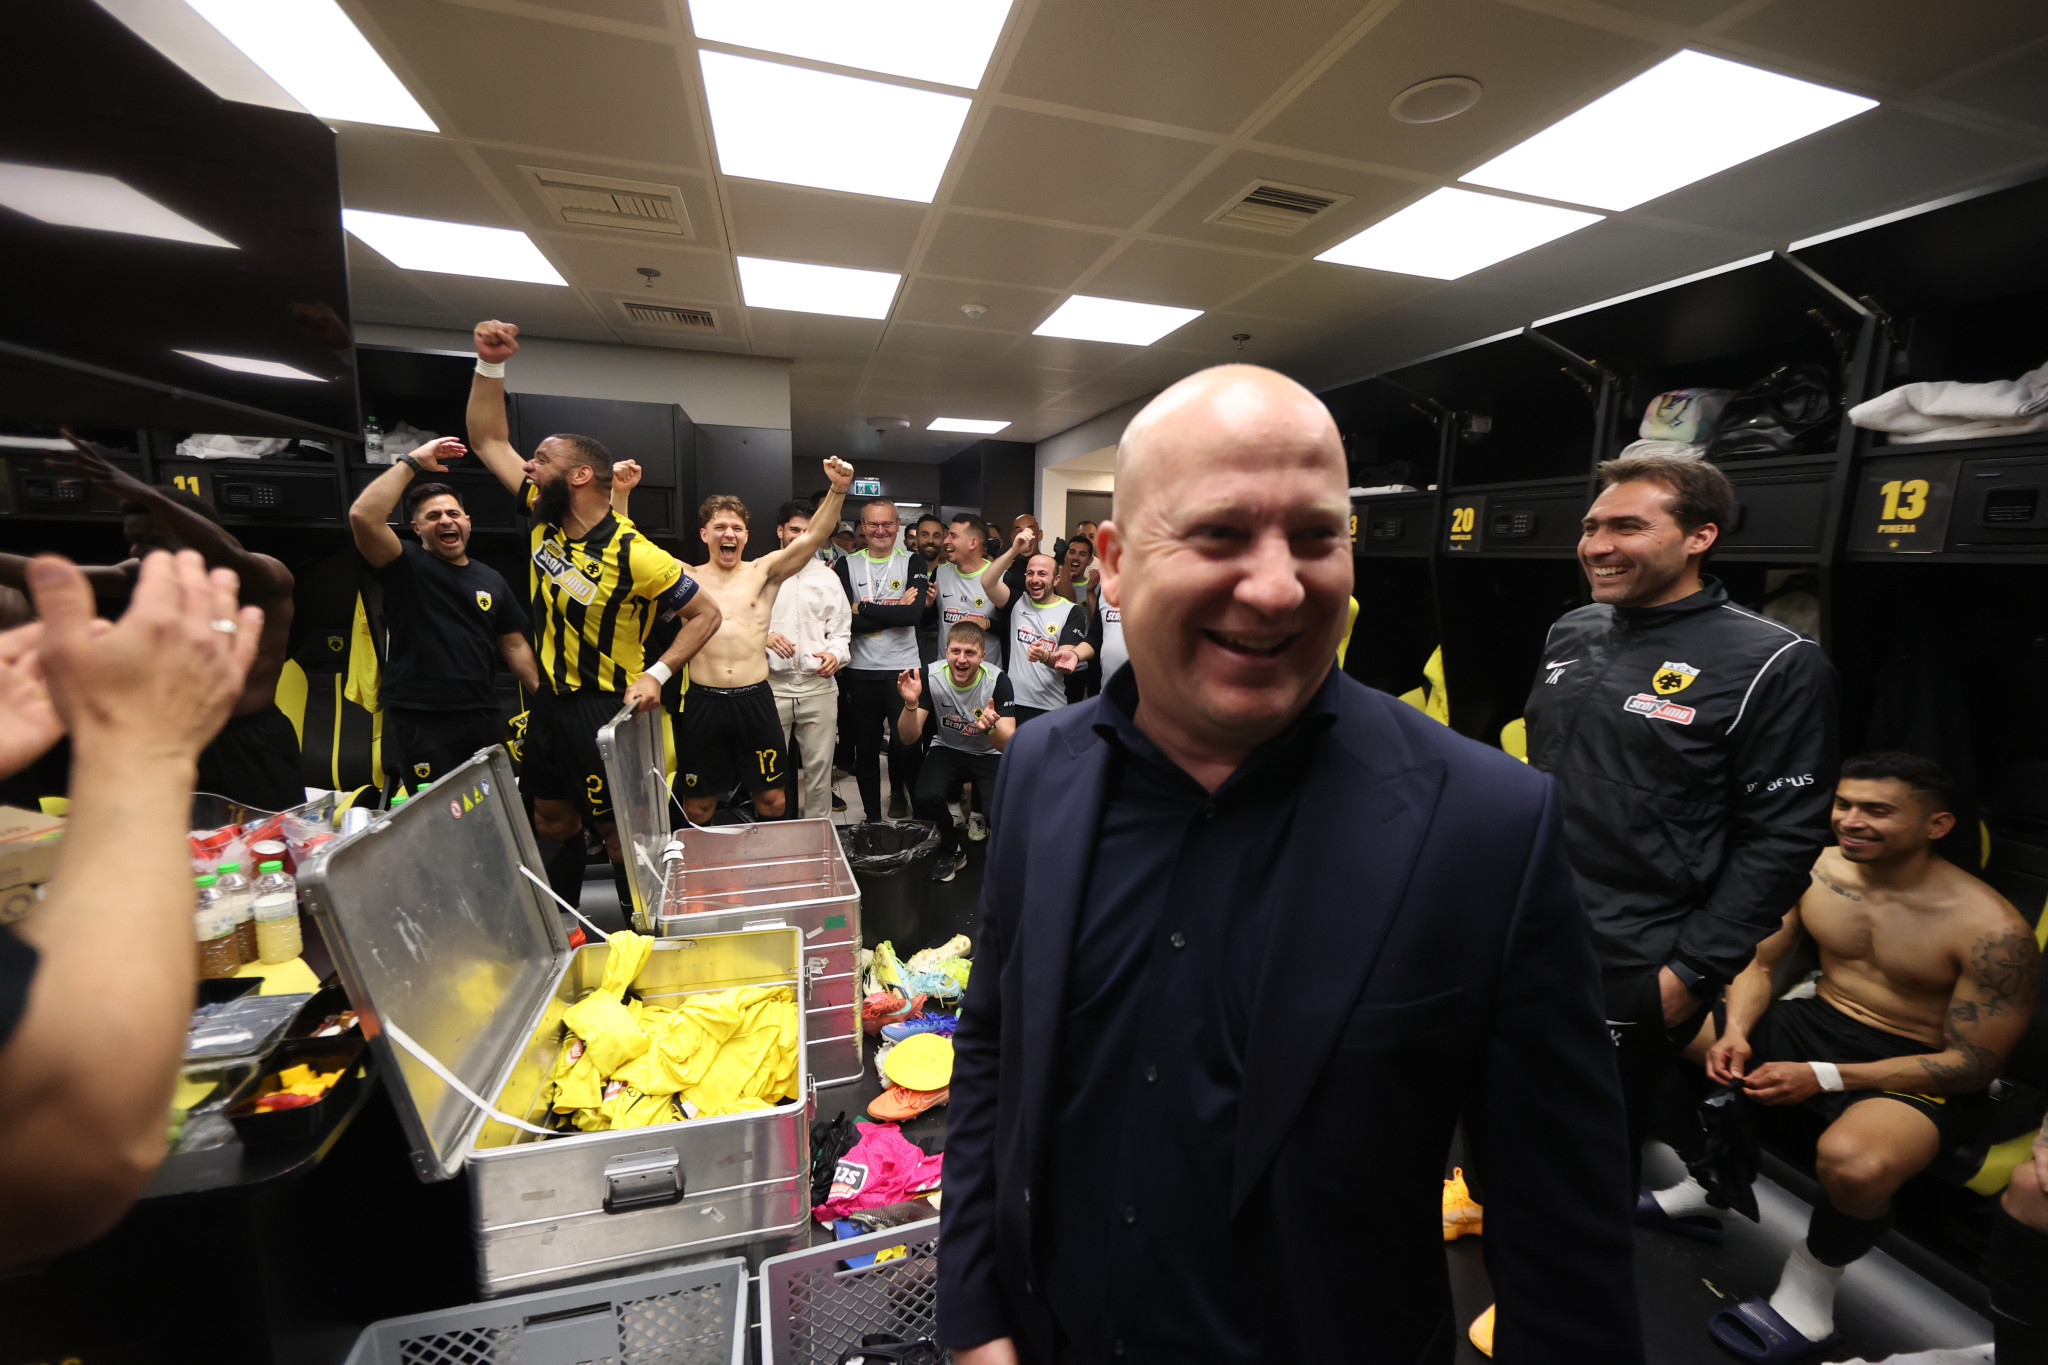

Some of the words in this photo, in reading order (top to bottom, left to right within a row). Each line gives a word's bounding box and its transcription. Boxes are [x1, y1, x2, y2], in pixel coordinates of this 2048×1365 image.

[173, 475, 200, 497] 11
[1880, 479, 1930, 520] 13
[1451, 507, 1475, 532] 20
[755, 748, 778, 775] 17
[585, 774, 603, 804] 2
